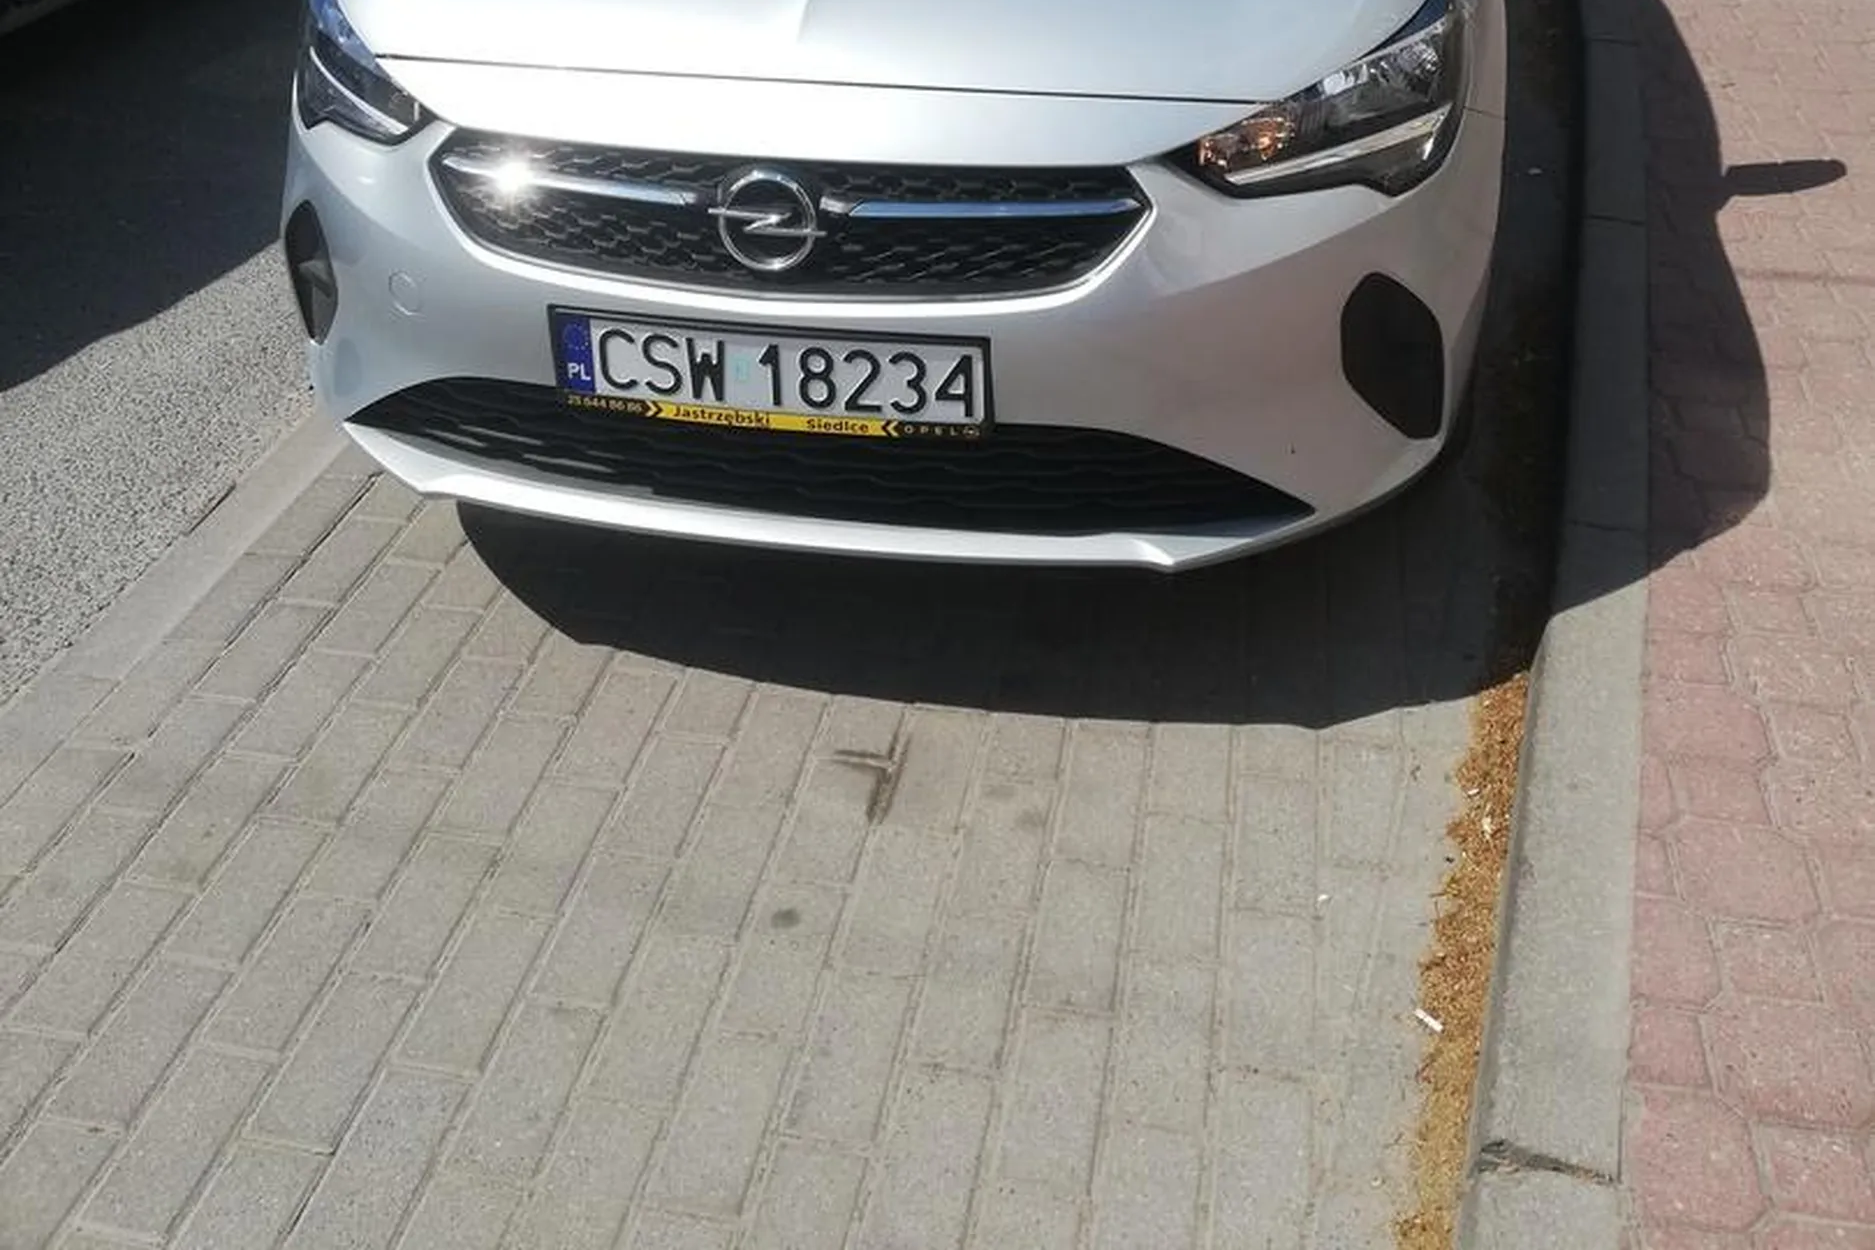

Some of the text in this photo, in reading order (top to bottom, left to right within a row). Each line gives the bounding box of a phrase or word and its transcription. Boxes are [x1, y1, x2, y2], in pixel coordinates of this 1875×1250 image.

[567, 363, 592, 381] PL
[599, 328, 974, 419] CSW 18234
[673, 405, 770, 426] Jastrzębski
[805, 418, 870, 434] Siedlce
[904, 424, 960, 436] OPEL
